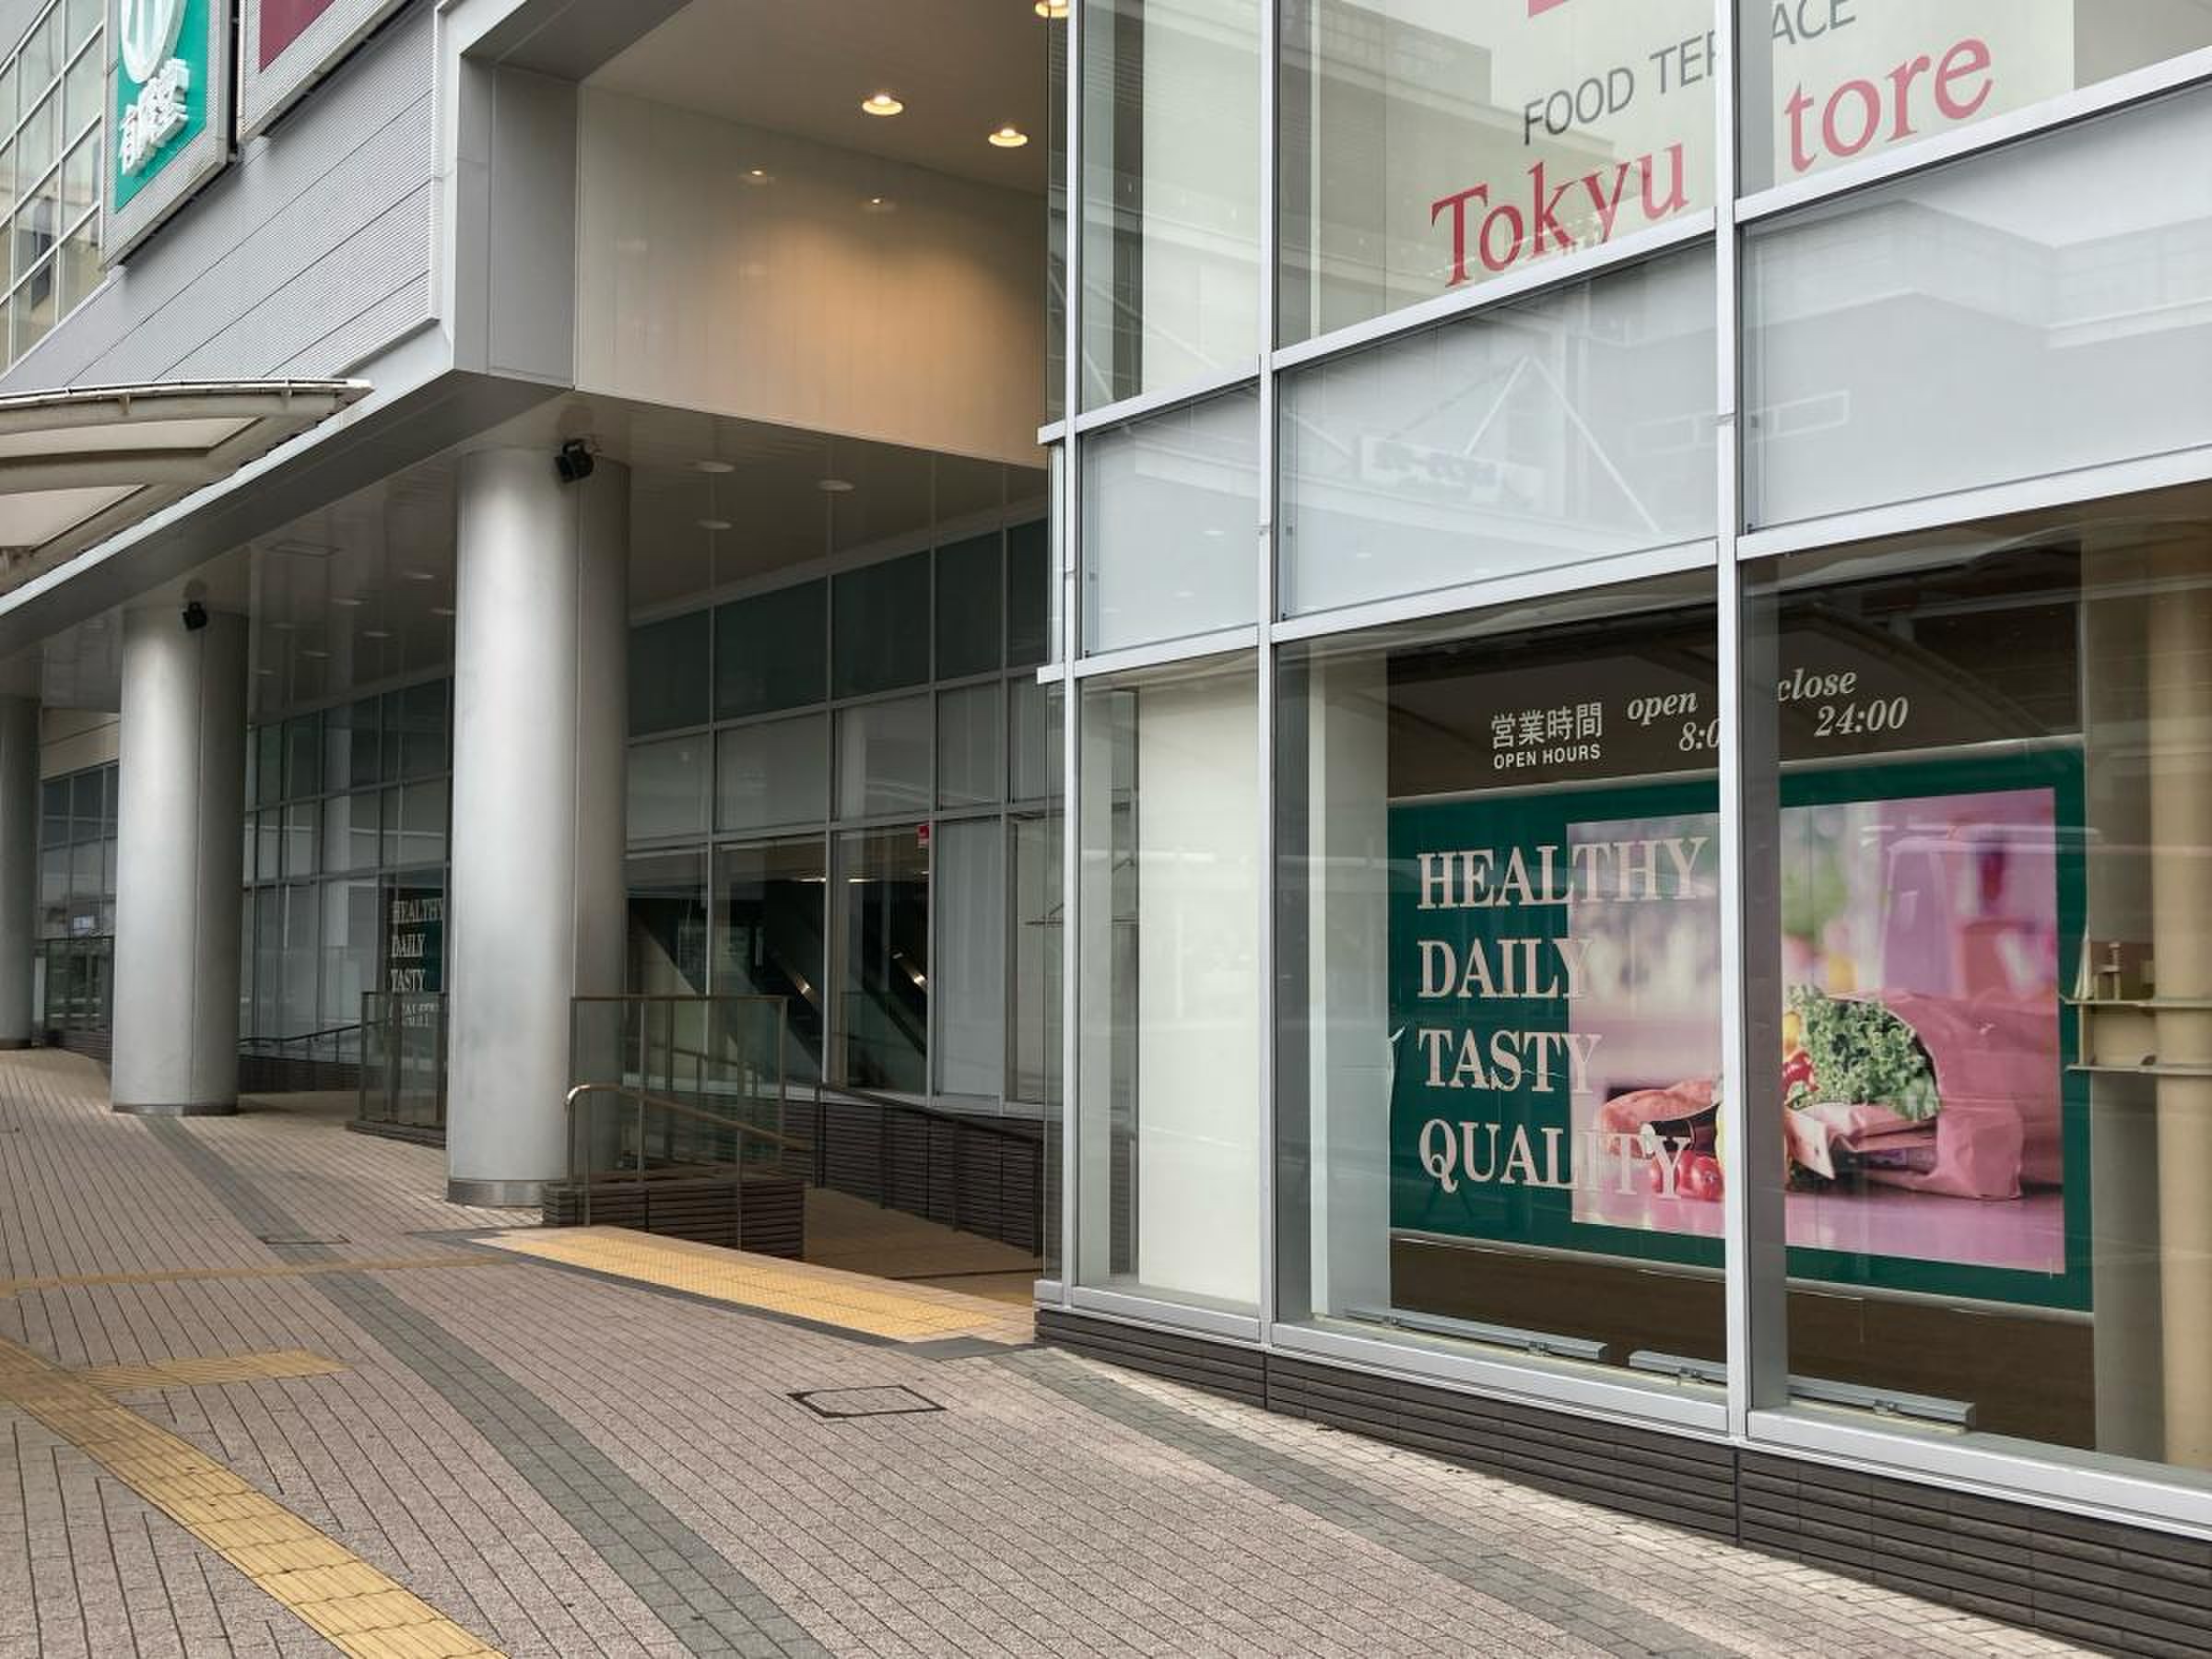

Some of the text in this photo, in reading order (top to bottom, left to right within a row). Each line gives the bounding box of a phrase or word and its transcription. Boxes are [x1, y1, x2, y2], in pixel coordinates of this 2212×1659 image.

[1524, 0, 1856, 146] FOOD TEACE
[1430, 38, 1993, 288] Tokyu tore
[1490, 702, 1603, 749] 営業時間
[1627, 666, 1858, 726] open close
[1678, 697, 1910, 751] 8:0 24:00
[1493, 743, 1602, 770] OPEN HOURS
[1417, 837, 1711, 911] HEALTHY
[391, 933, 427, 959] DAILY
[1417, 936, 1594, 1000] DAILY
[390, 969, 427, 993] TASTY
[1418, 1028, 1603, 1094] TASTY
[1418, 1118, 1692, 1199] QUALITY
